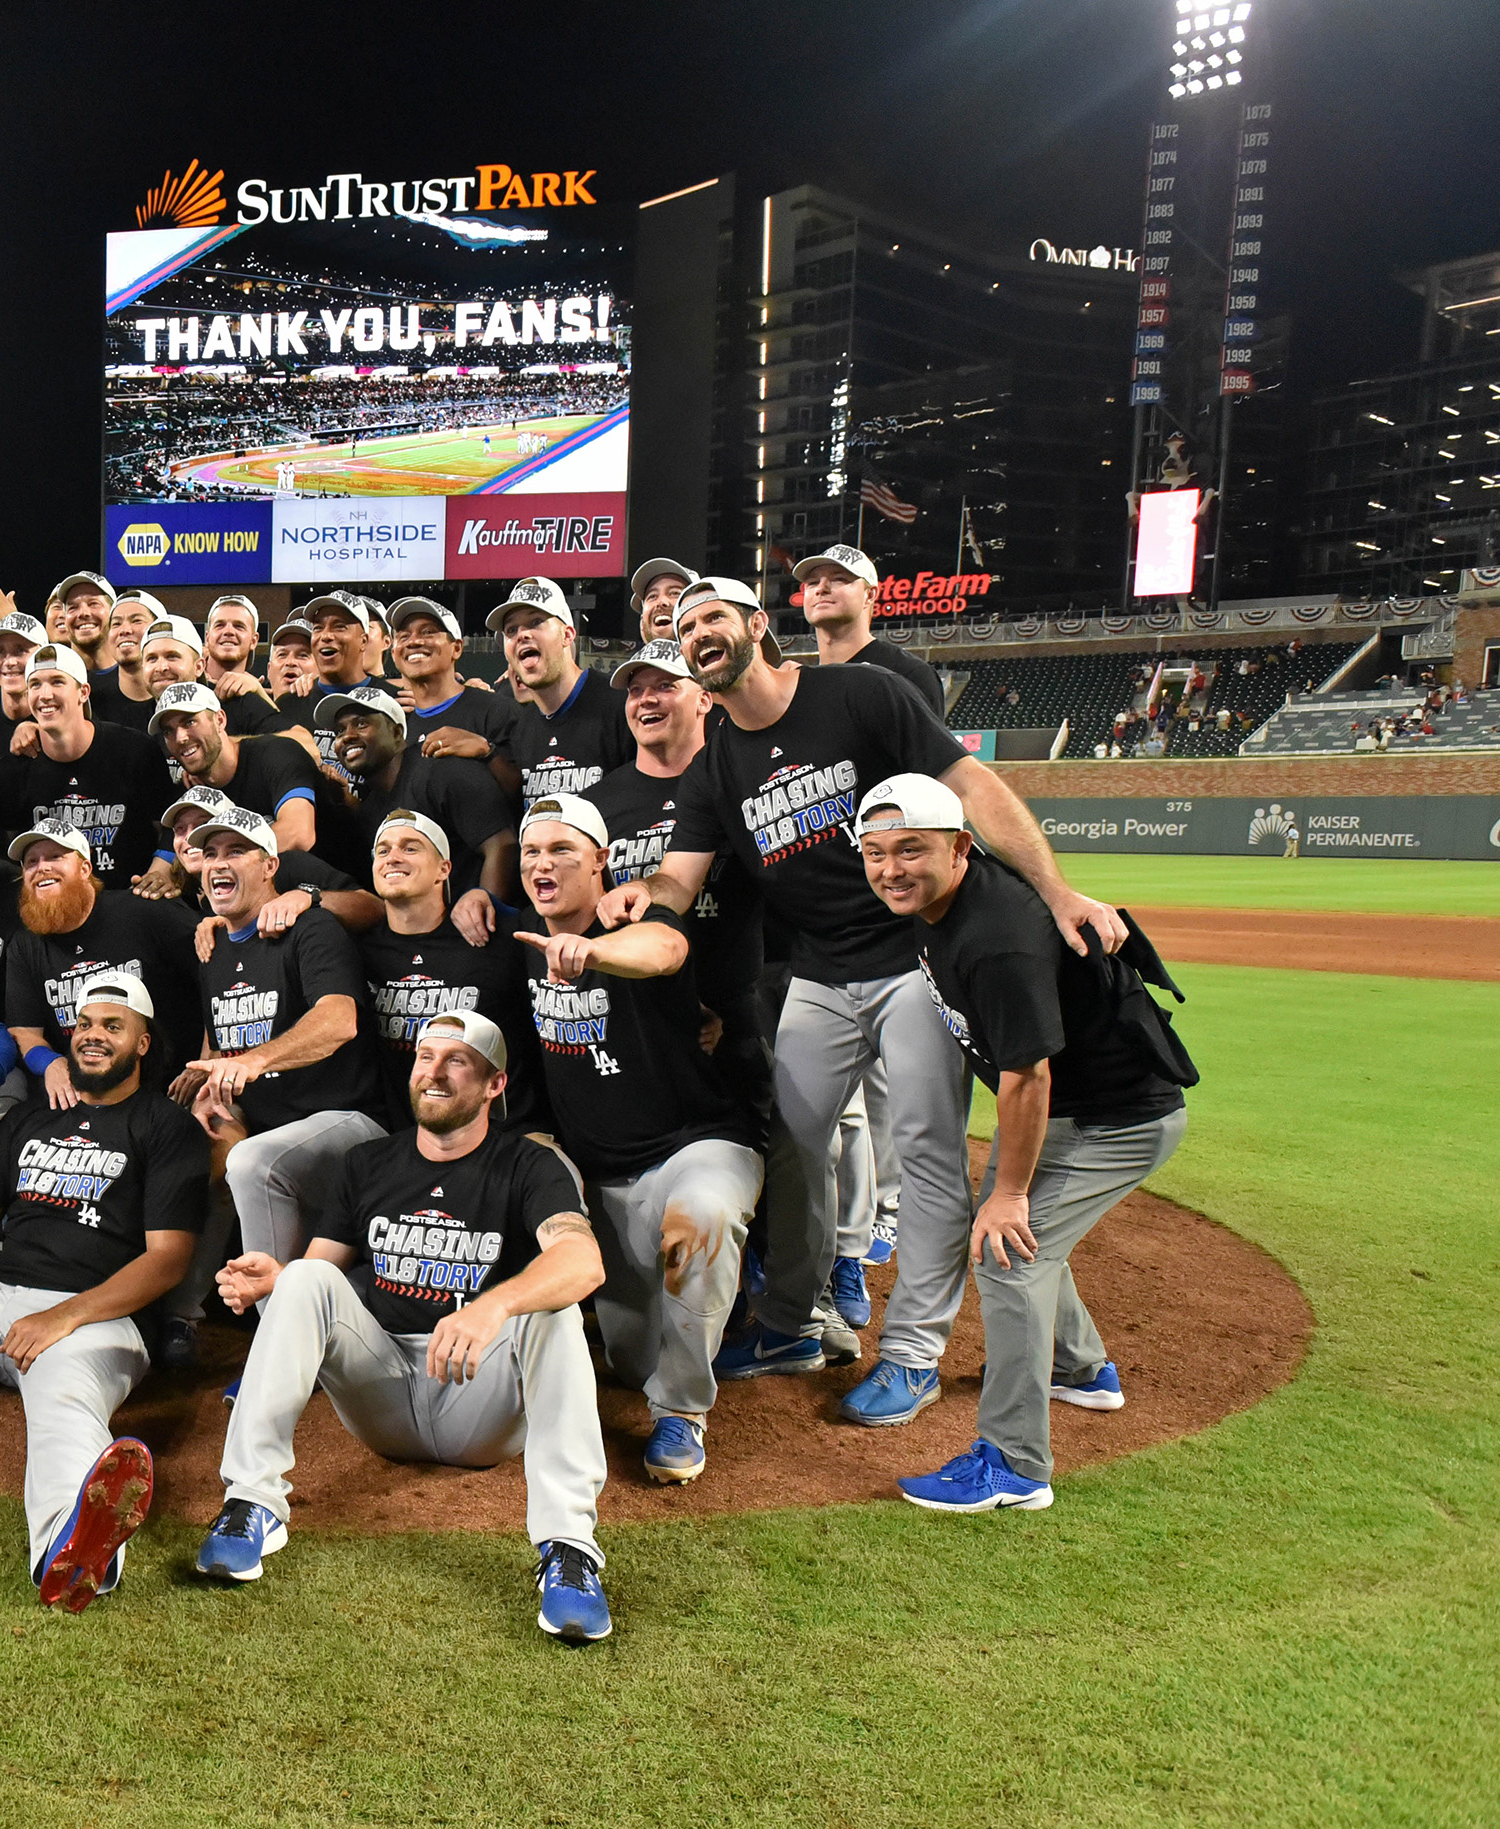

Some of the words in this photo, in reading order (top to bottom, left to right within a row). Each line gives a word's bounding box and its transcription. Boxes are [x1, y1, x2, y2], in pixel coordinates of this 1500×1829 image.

[1245, 104, 1271, 120] 1873
[1155, 124, 1179, 138] 1872
[1243, 132, 1269, 147] 1875
[1153, 151, 1177, 165] 1874
[1241, 160, 1267, 174] 1878
[475, 164, 597, 211] PARK
[1151, 177, 1175, 192] 1877
[1239, 187, 1264, 202] 1891
[1149, 204, 1174, 218] 1883
[1236, 214, 1263, 229] 1893
[1147, 231, 1172, 244] 1892
[1030, 239, 1088, 266] OMNI
[1234, 242, 1261, 256] 1898
[1145, 257, 1169, 271] 1897
[1232, 269, 1258, 283] 1948
[1143, 283, 1166, 296] 1914
[1230, 296, 1256, 309] 1958
[1141, 309, 1164, 322] 1957
[136, 312, 312, 361] THANK
[318, 305, 435, 357] YOU,
[455, 297, 612, 348] FANS!
[1227, 323, 1253, 337] 1982
[1139, 335, 1164, 348] 1969
[1225, 350, 1251, 363] 1992
[1137, 361, 1160, 374] 1991
[1223, 376, 1249, 389] 1995
[1135, 387, 1160, 400] 1993
[349, 511, 367, 520] NH
[281, 523, 437, 544] NORTHSIDE
[458, 518, 559, 556] Kauffman
[532, 515, 613, 554] TIRE
[126, 534, 163, 555] NAPA
[174, 533, 219, 554] KNOW
[225, 530, 259, 552] HOW
[308, 547, 407, 560] HOSPITAL
[872, 597, 967, 618] BORHOOD
[759, 763, 815, 793] POSTSEASON
[741, 760, 858, 831] CHASING
[1166, 802, 1192, 812] 375
[754, 788, 857, 857] H18TORY
[1041, 818, 1117, 839] Georgia
[1124, 818, 1188, 837] Power
[1308, 815, 1359, 829] KAISER
[1306, 833, 1414, 847] PERMANENTE
[95, 847, 114, 871] LA
[695, 886, 718, 917] LA
[61, 960, 110, 979] POSTSEASON
[386, 980, 445, 988] POSTSEASON
[367, 981, 480, 1015] HASING
[211, 990, 278, 1026] CHASING
[588, 1044, 621, 1076] LA
[50, 1137, 100, 1148] POSTSEASON
[18, 1139, 130, 1179] CHASING
[16, 1168, 117, 1201] H18TORY
[77, 1200, 102, 1228] LA
[399, 1214, 467, 1229] POSTSEASON
[368, 1216, 503, 1264] CHASING
[373, 1252, 493, 1292] H18TORY
